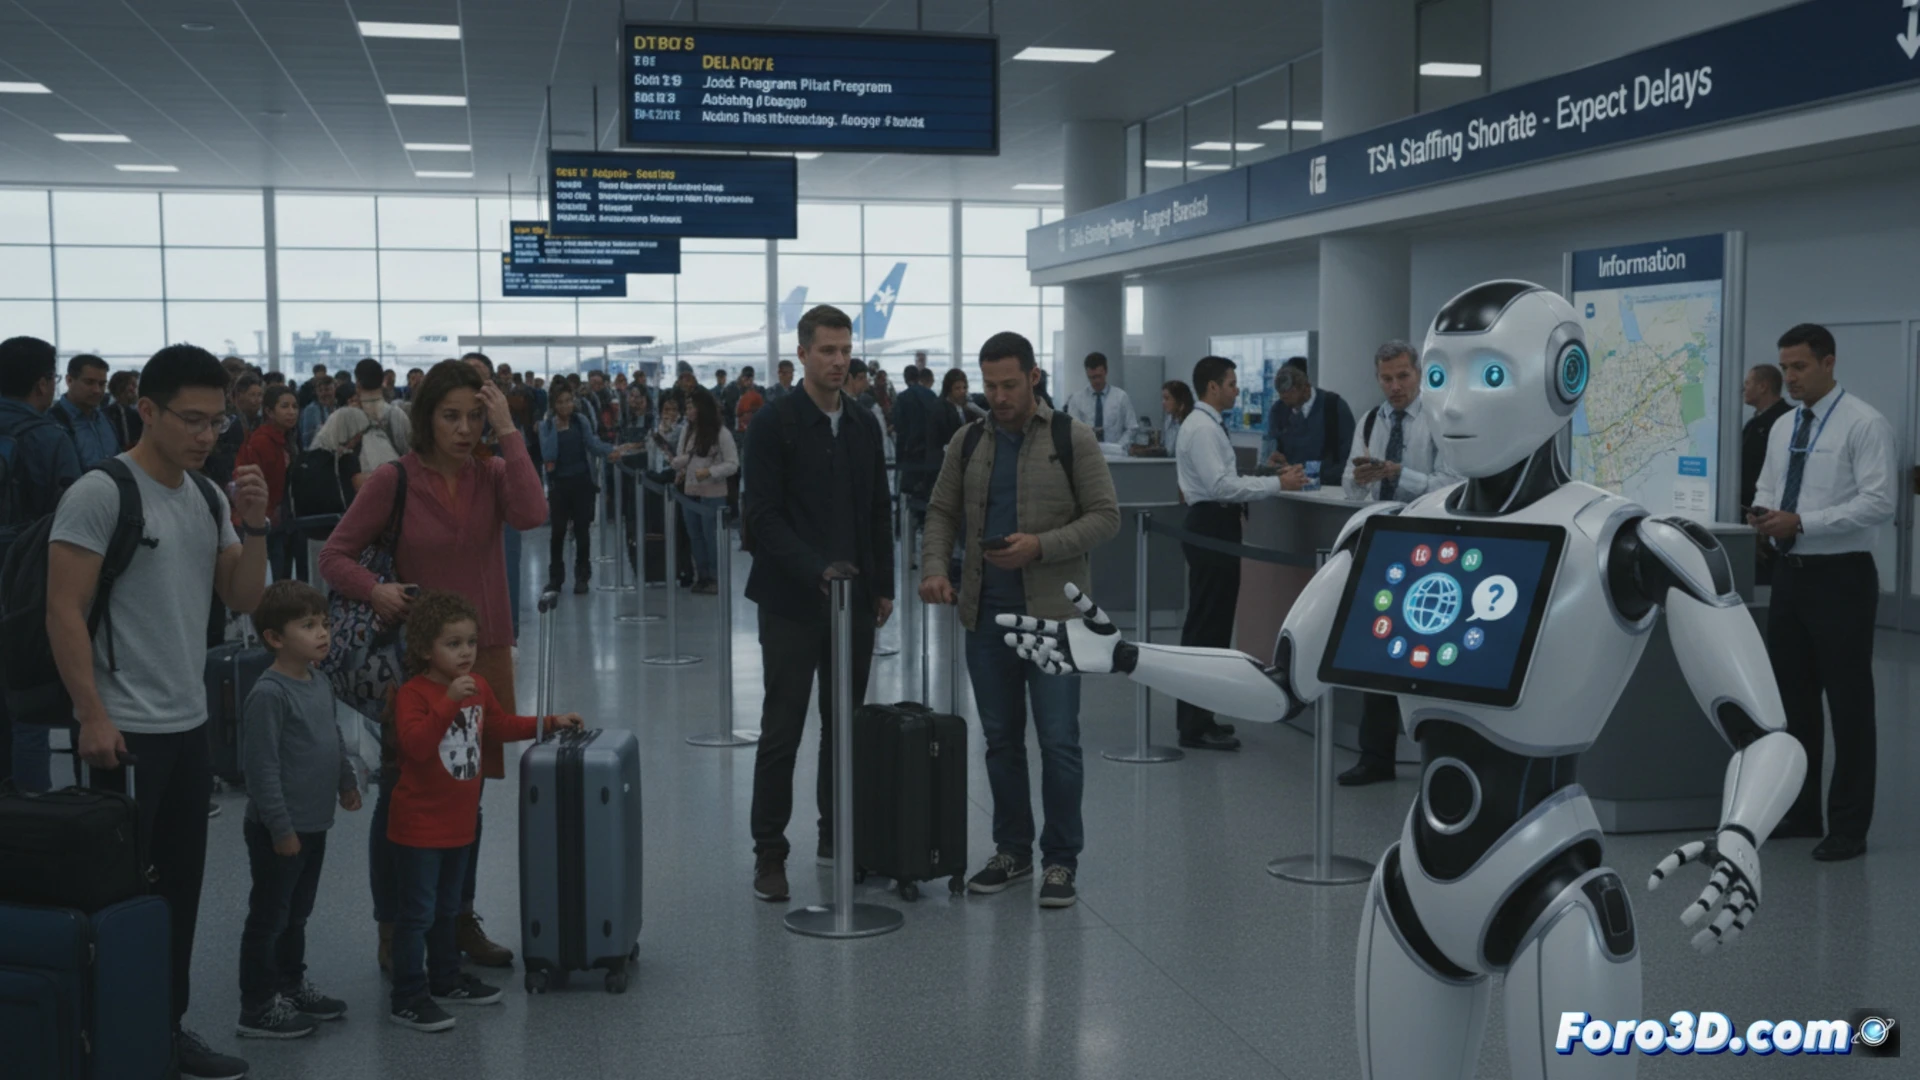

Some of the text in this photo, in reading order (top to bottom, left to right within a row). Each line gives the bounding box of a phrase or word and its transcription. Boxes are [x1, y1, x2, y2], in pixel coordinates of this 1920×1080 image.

[1367, 142, 1397, 175] TSA
[1400, 129, 1463, 167] Staffing
[1557, 83, 1628, 133] Expect
[1634, 66, 1712, 112] Delays
[1598, 246, 1686, 278] Information
[1488, 583, 1505, 612] ?
